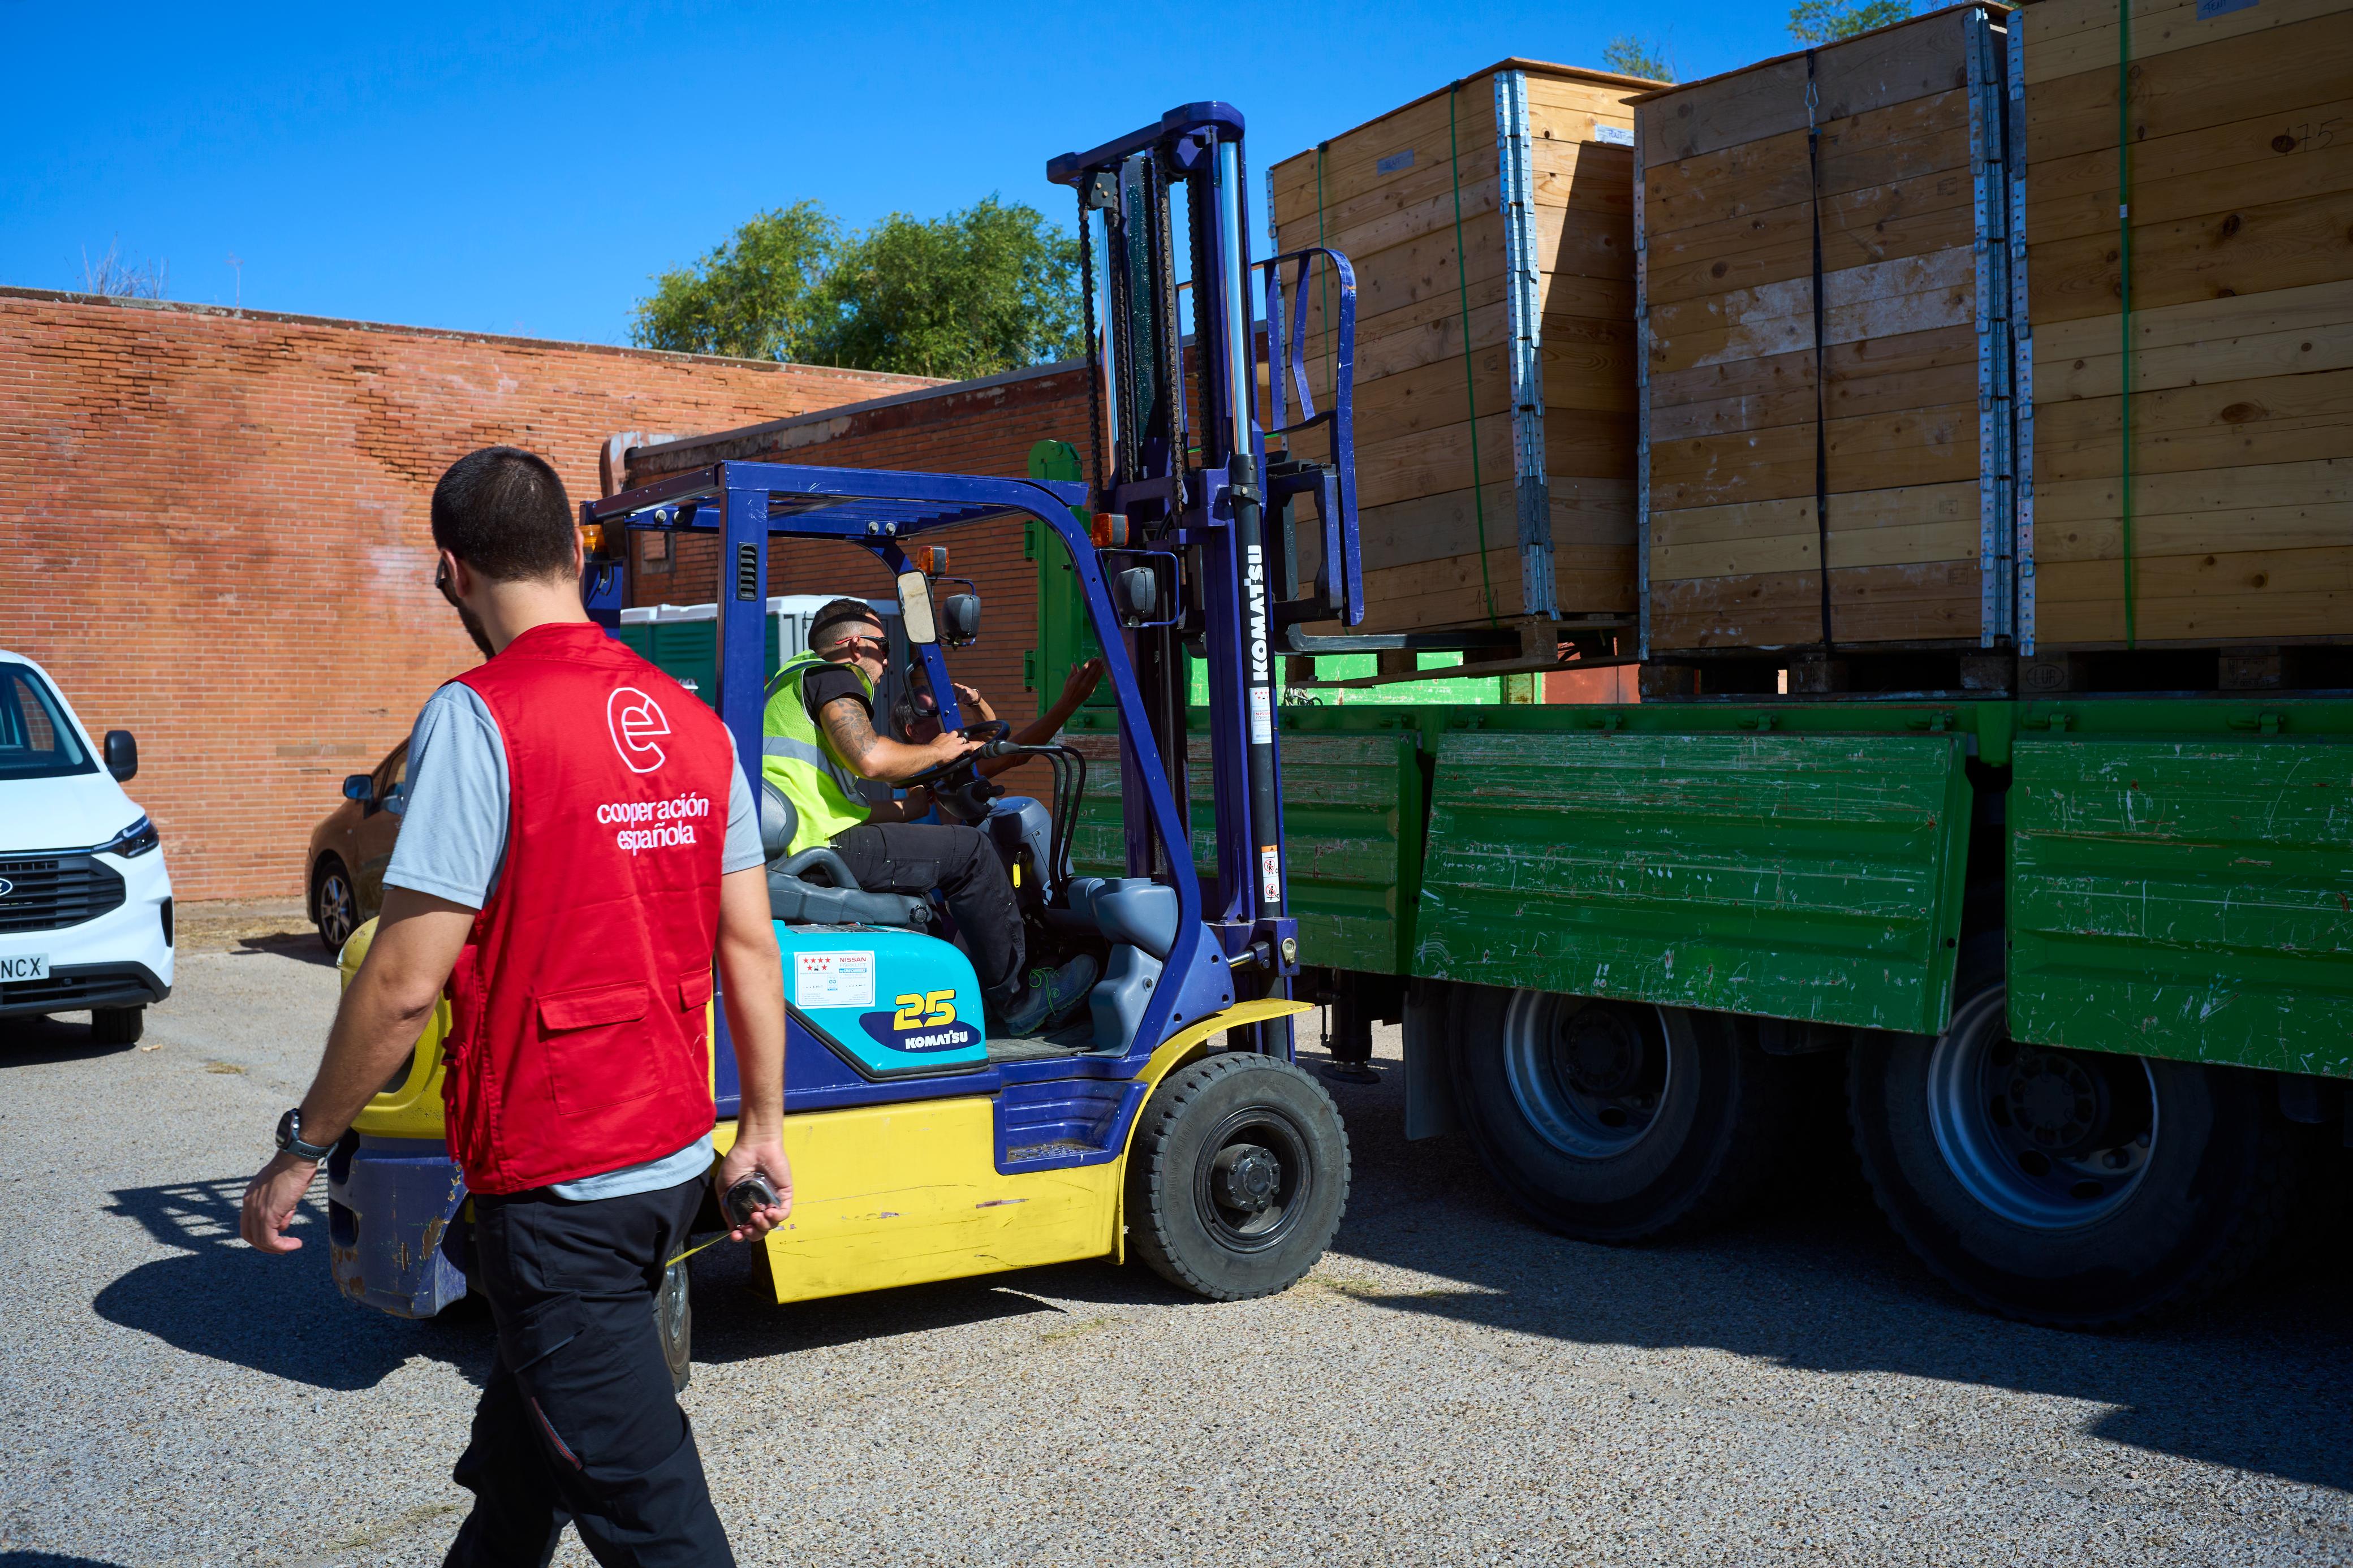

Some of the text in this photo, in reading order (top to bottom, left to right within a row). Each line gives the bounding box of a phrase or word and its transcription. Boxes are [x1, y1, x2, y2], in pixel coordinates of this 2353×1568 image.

[1244, 545, 1269, 681] KOMATSU
[597, 792, 709, 828] cooperación
[617, 820, 697, 856] española
[1, 957, 41, 979] NCX
[893, 988, 957, 1031] 25
[905, 1030, 968, 1049] KOMATSU
